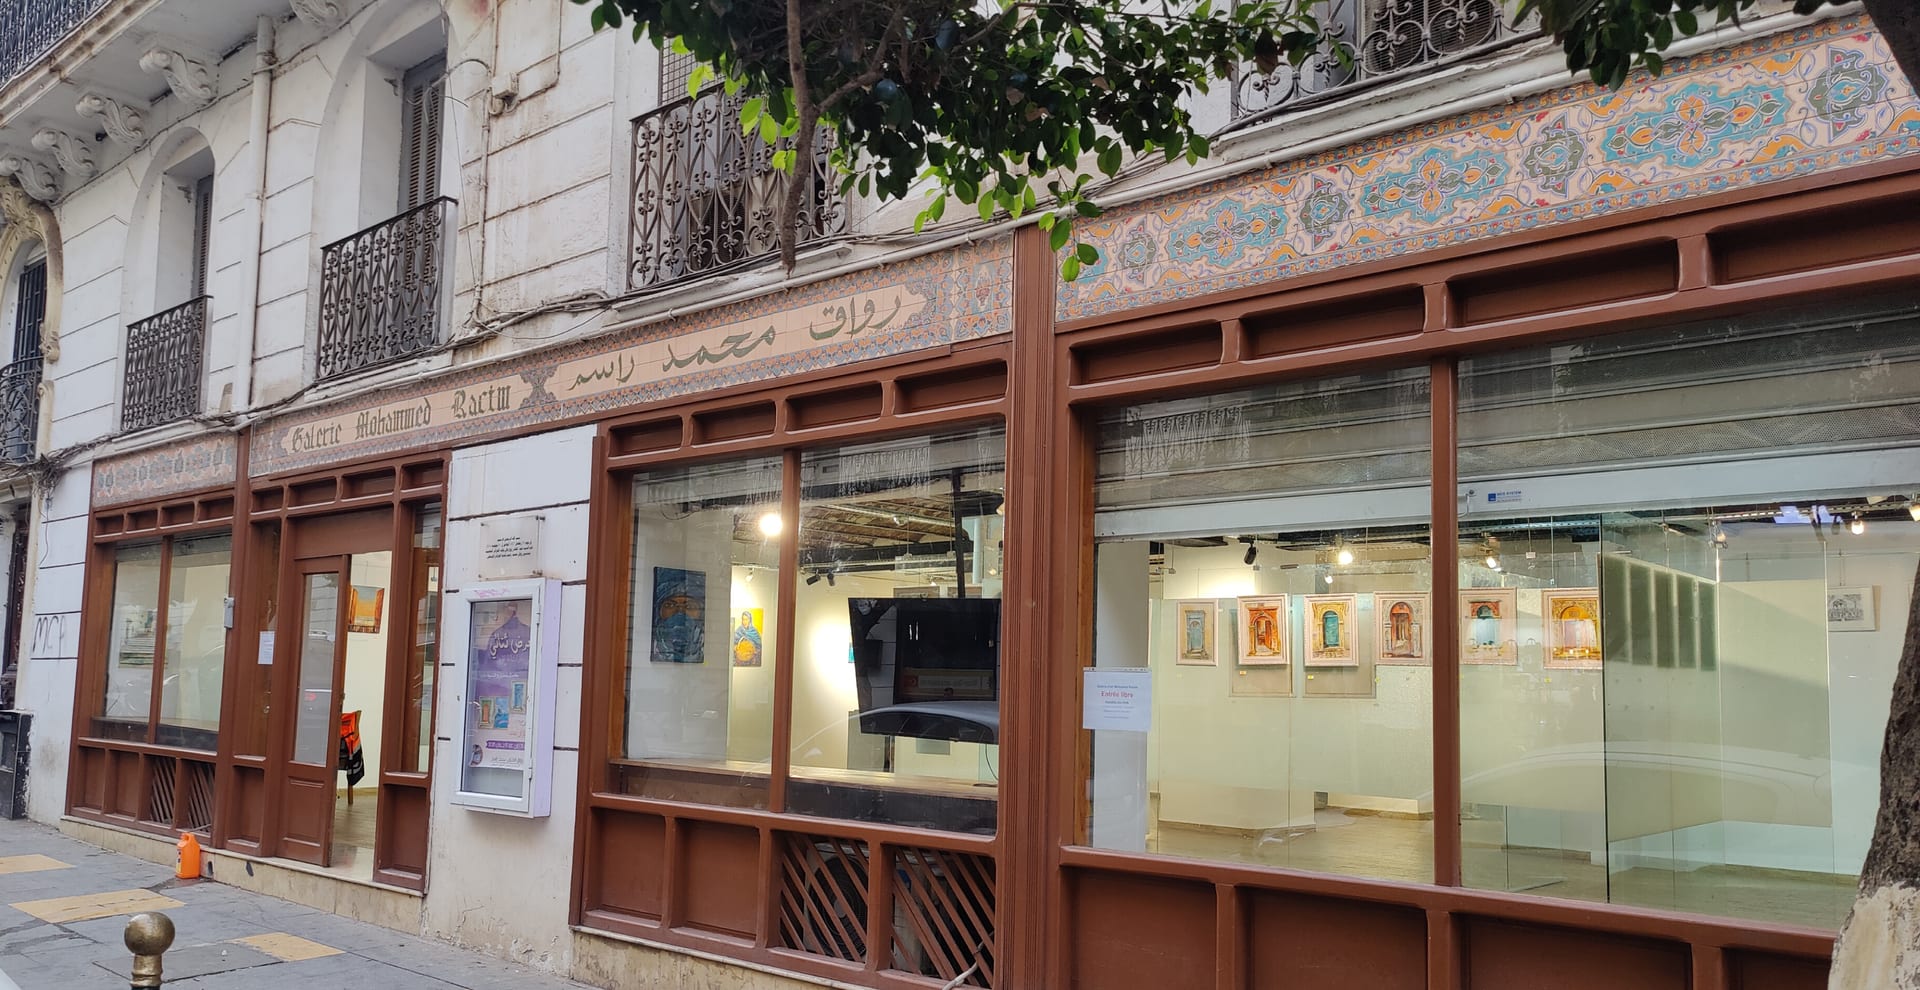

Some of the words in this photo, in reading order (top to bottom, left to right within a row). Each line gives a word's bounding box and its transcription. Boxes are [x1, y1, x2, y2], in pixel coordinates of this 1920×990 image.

[809, 295, 901, 341] رواق
[661, 325, 777, 372] محمد
[567, 352, 635, 392] راسم
[291, 421, 342, 452] Galerie
[355, 397, 432, 440] Mohammed
[451, 384, 512, 419] Racim
